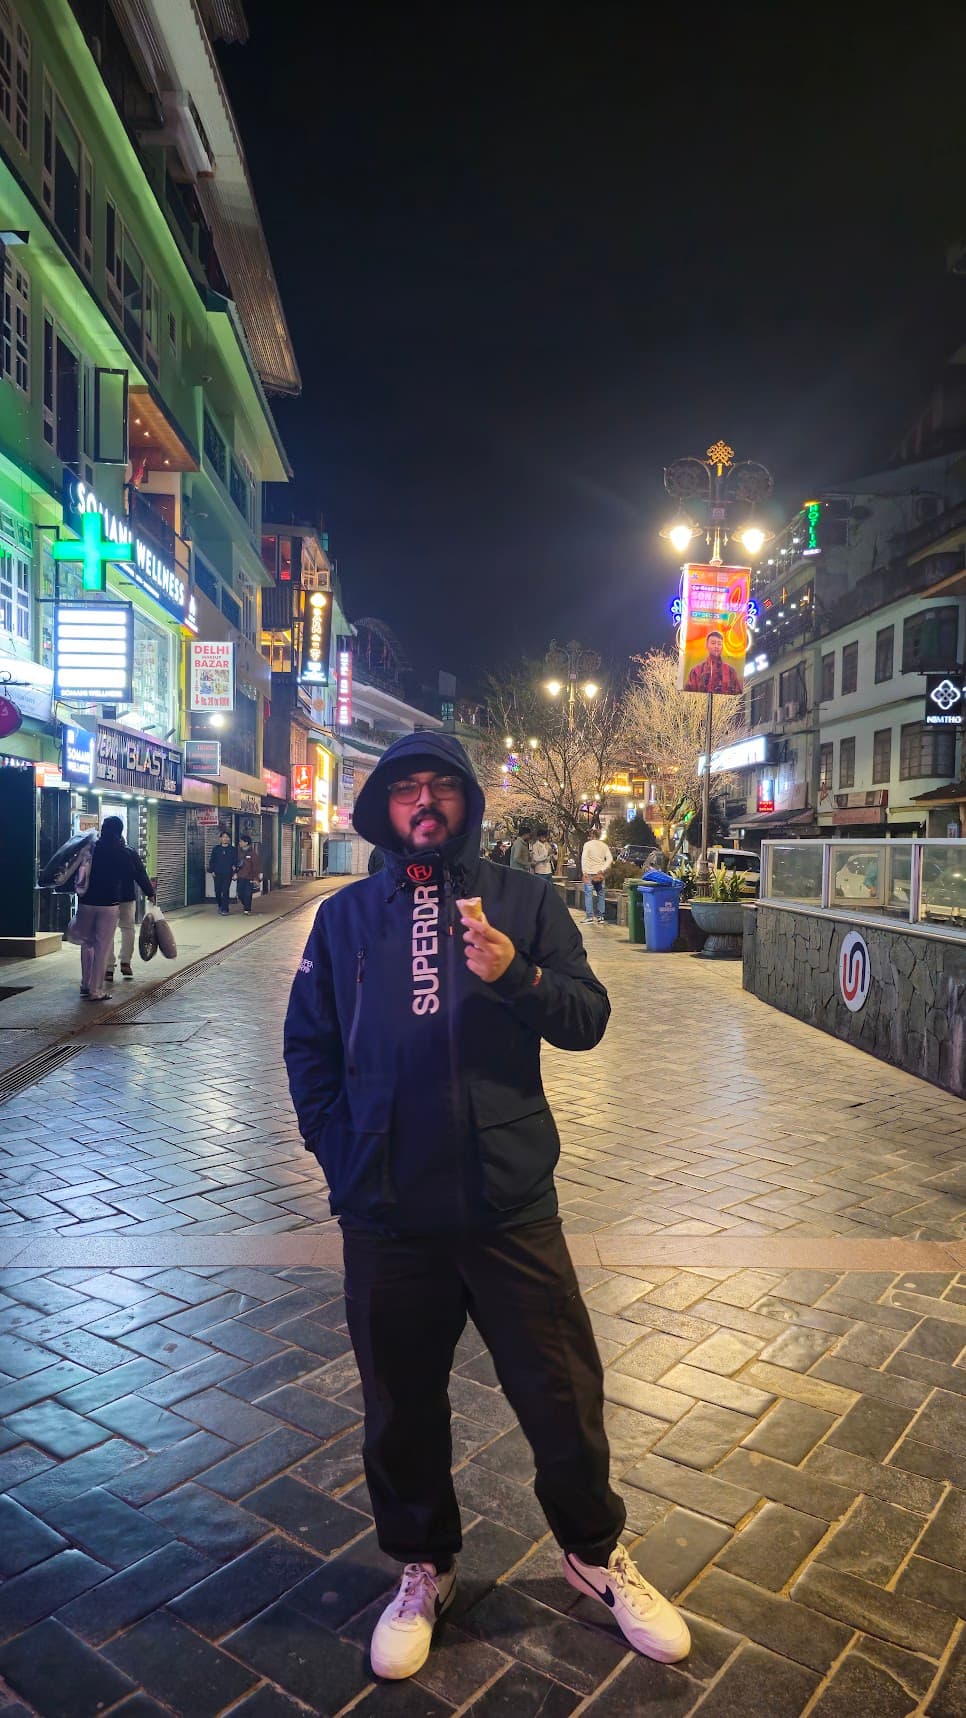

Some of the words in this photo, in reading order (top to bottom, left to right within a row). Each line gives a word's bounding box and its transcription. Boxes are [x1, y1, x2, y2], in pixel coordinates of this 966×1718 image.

[136, 539, 185, 607] WELLNESS
[194, 645, 230, 655] DELHI
[194, 659, 229, 668] BAZAR
[926, 715, 962, 724] NIMTHO
[126, 741, 166, 777] BLAST
